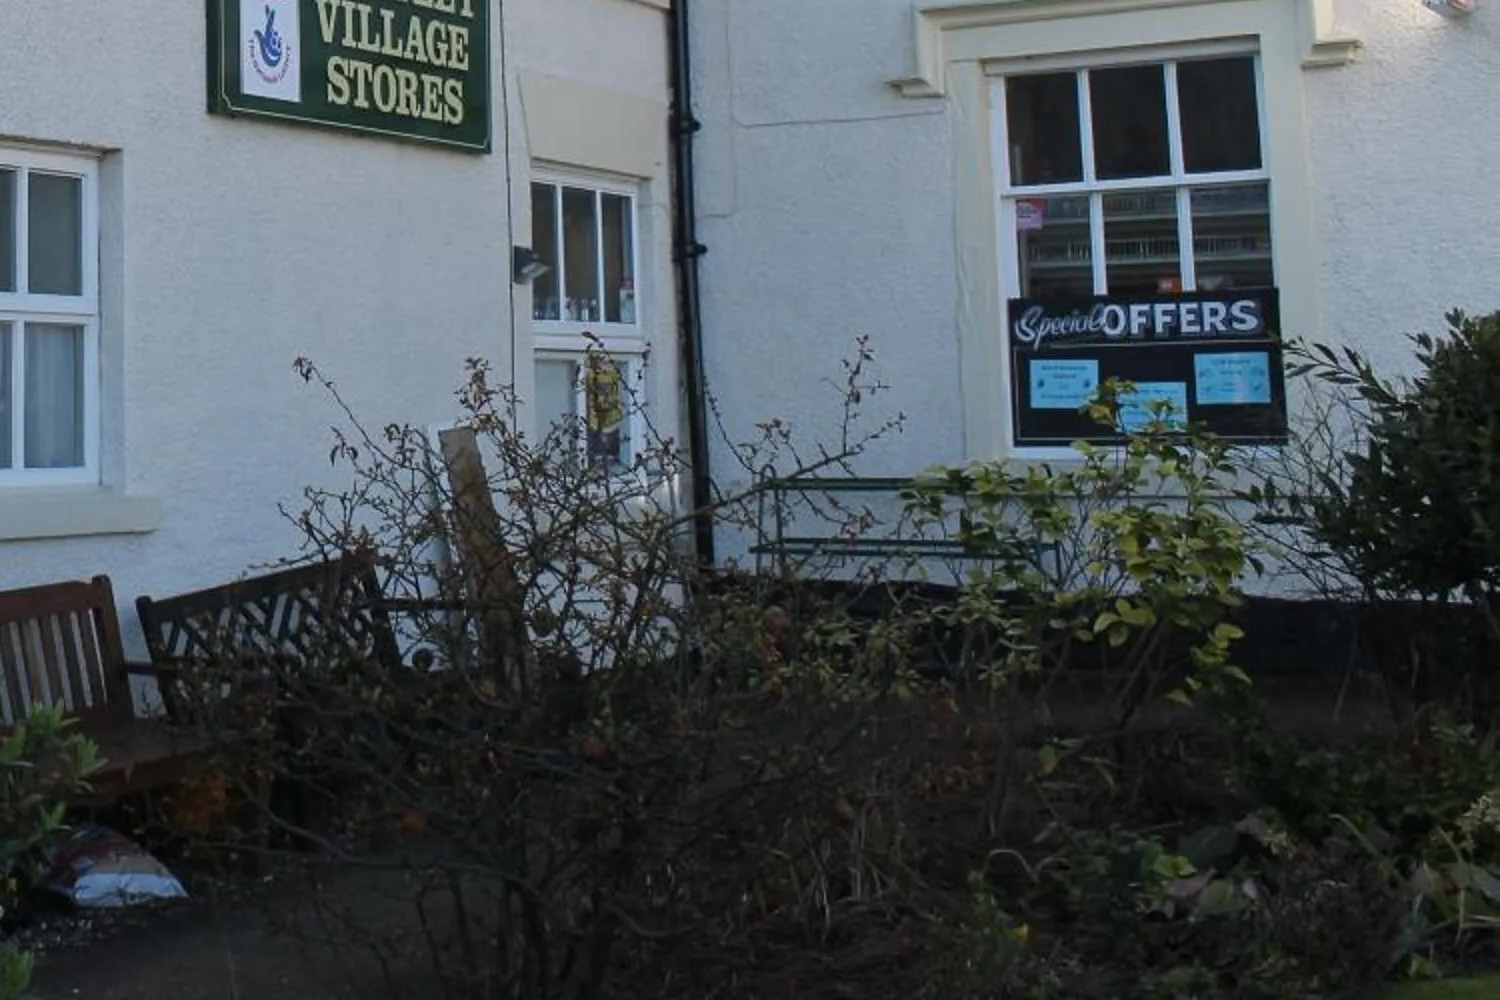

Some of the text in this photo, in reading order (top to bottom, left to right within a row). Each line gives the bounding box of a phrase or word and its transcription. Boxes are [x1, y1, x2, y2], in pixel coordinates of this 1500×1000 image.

[327, 55, 463, 125] STORES
[1015, 300, 1258, 350] Special OFFERS
